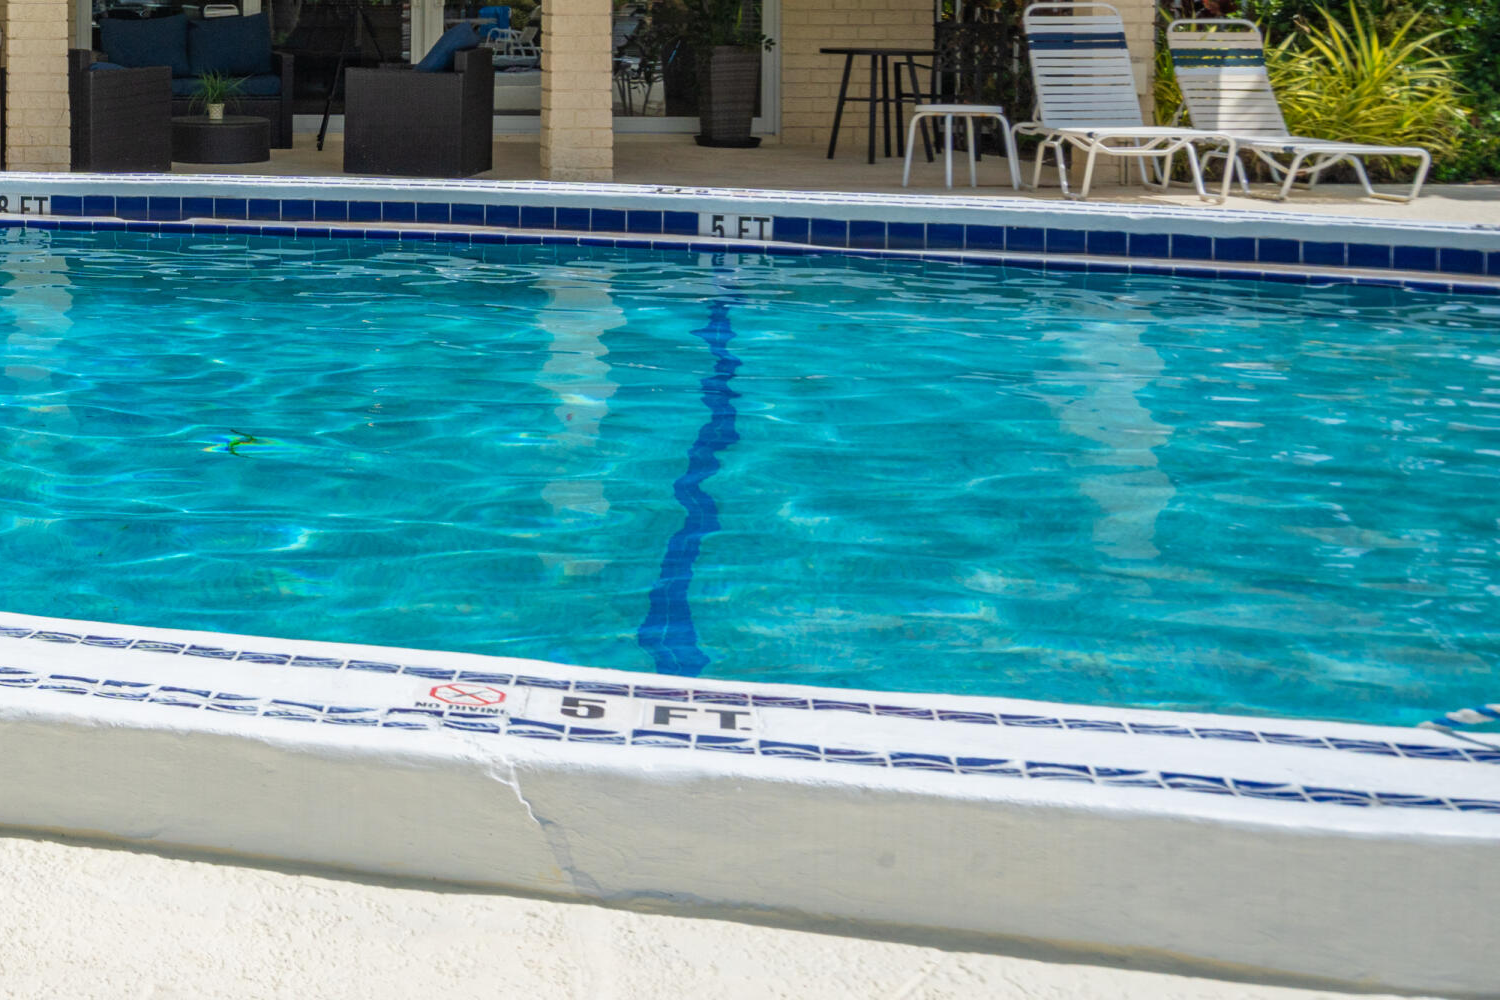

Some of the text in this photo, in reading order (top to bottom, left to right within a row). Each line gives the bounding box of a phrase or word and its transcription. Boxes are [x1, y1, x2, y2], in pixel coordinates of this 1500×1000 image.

[20, 196, 48, 215] FT
[711, 215, 770, 240] 5 FT
[414, 701, 440, 709] NO
[560, 697, 607, 720] 5
